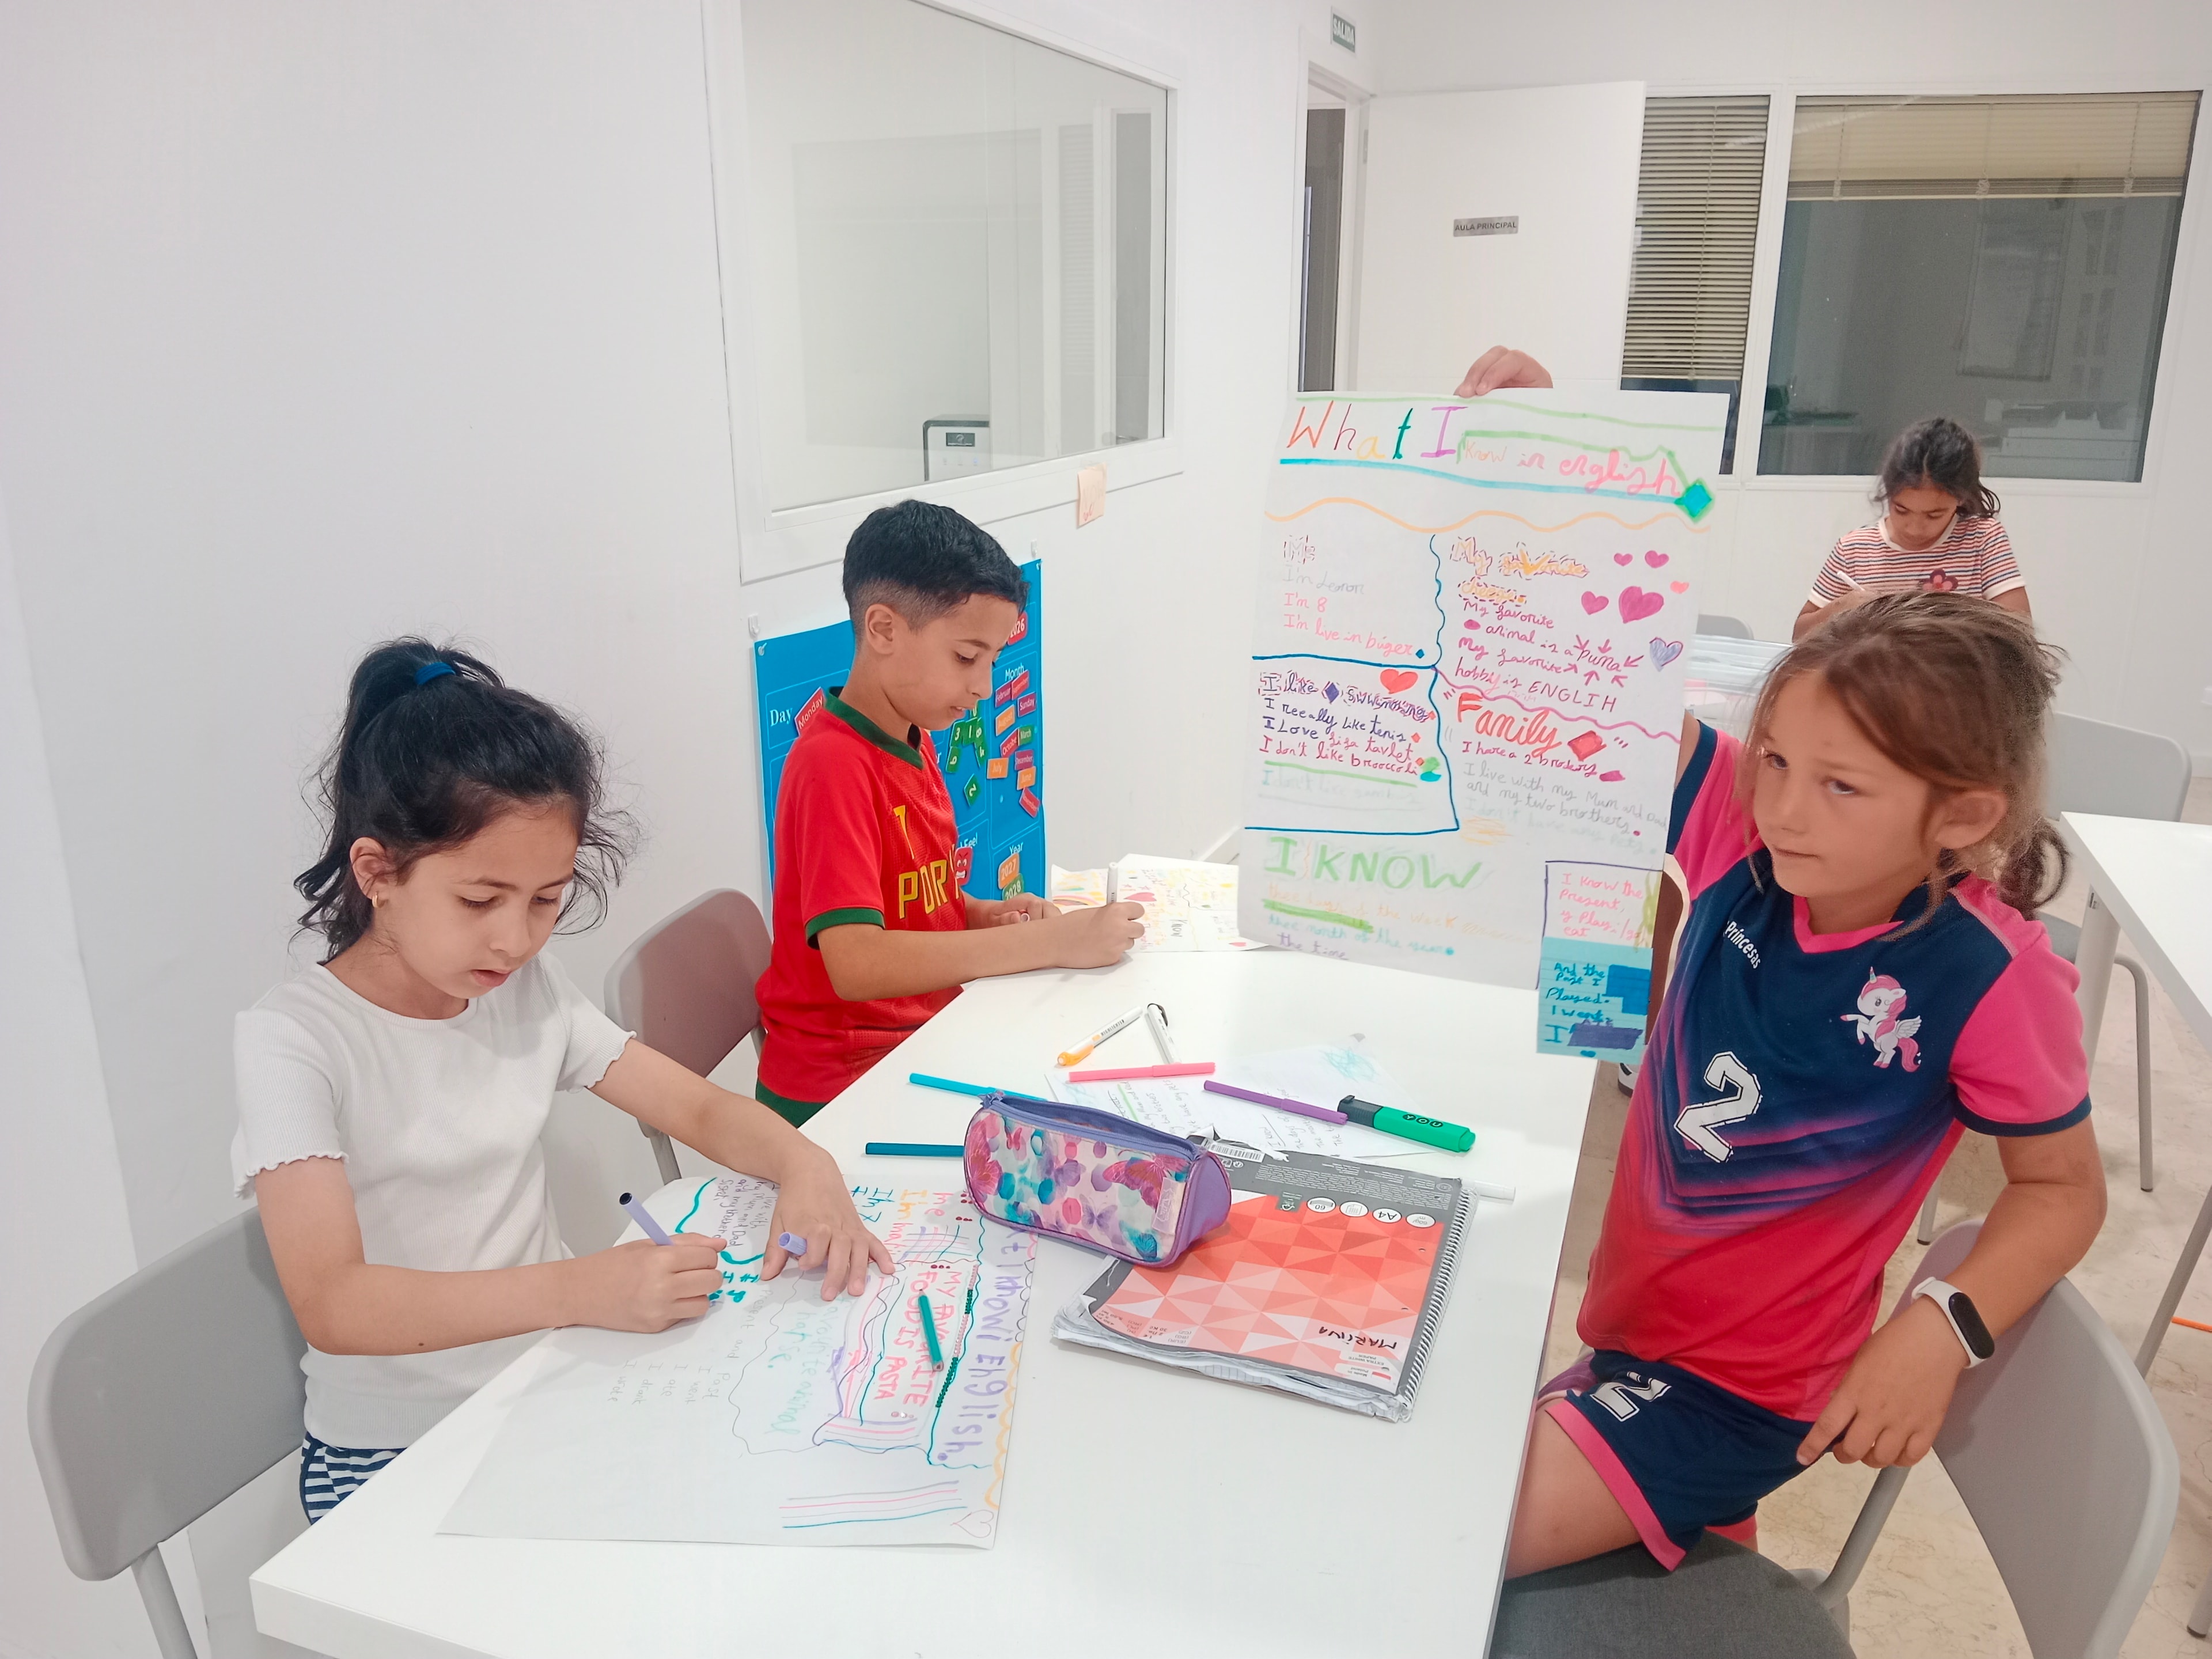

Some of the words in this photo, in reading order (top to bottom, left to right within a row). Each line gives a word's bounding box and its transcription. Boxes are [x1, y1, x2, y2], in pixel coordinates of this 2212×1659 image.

[1333, 18, 1355, 46] SALIDA
[1455, 223, 1475, 231] AULA
[1476, 221, 1517, 230] PRINCIPAL
[1286, 400, 1413, 460] What
[1317, 596, 1328, 613] 8
[1464, 601, 1489, 618] My
[1005, 663, 1024, 681] Month
[1019, 698, 1035, 711] Sunday
[1528, 680, 1618, 713] ENGLIH
[770, 708, 793, 727] Day
[798, 695, 823, 730] Monday
[954, 727, 961, 741] 3
[1458, 692, 1562, 759] Family
[1524, 754, 1533, 765] 2
[964, 832, 978, 848] Feel
[1009, 842, 1024, 855] Year
[1001, 858, 1017, 881] 2027
[1264, 836, 1298, 877] I
[1314, 844, 1483, 889] KNOW
[1562, 873, 1572, 885] I
[1005, 880, 1021, 900] 2028
[1725, 920, 1761, 970] Princesas
[1673, 1051, 1763, 1164] 2
[1403, 1113, 1444, 1128] YOU
[1377, 1210, 1398, 1221] A4
[935, 1271, 963, 1298] MY
[893, 1325, 921, 1350] IS
[873, 1355, 908, 1400] PASTA
